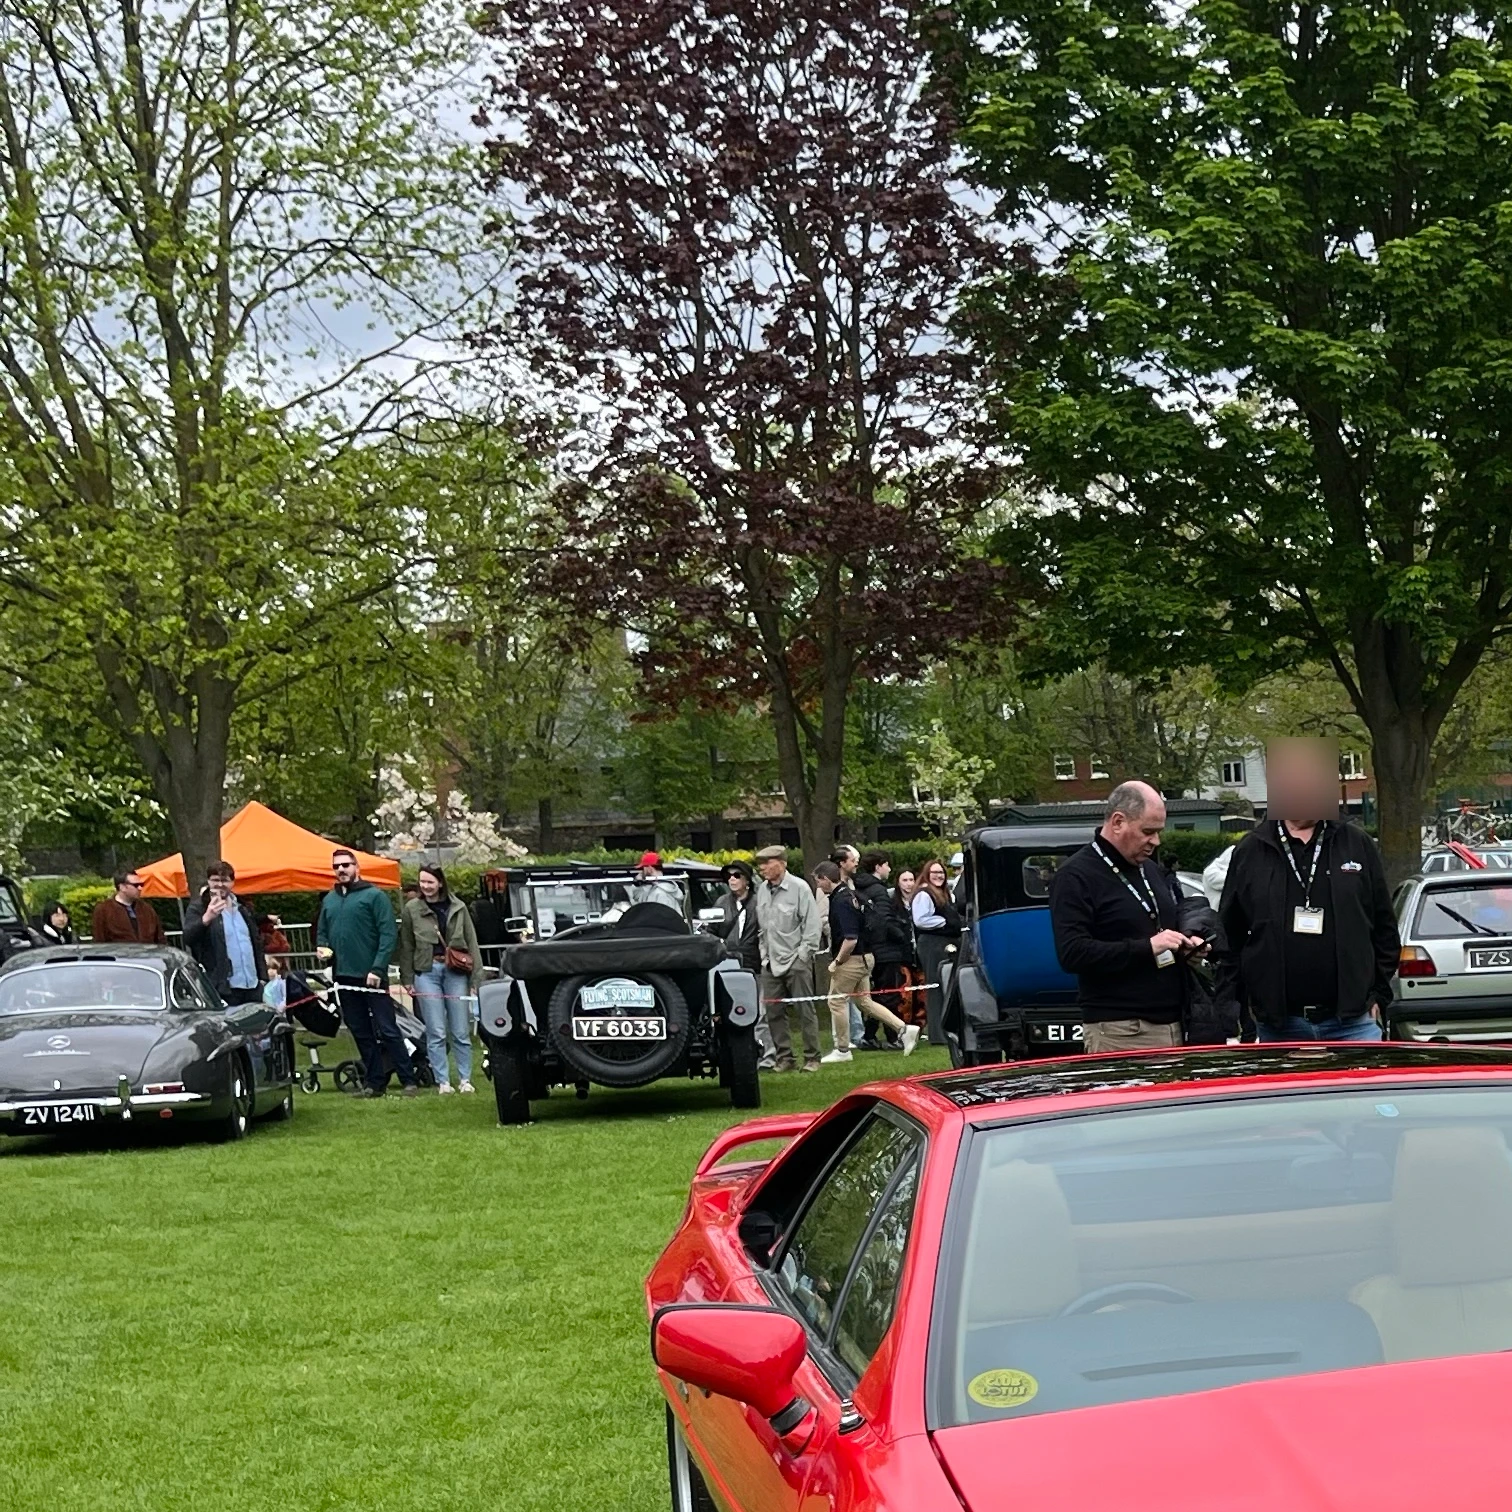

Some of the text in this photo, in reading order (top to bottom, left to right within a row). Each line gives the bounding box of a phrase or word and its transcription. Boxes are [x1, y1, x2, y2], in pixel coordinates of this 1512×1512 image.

[1475, 950, 1511, 966] FZS
[583, 986, 652, 1004] FLYING SCOTSMAN
[579, 1020, 661, 1037] YF 6035
[1047, 1024, 1065, 1041] EI
[23, 1104, 95, 1125] ZV 12411
[985, 1375, 1023, 1387] CLUB
[981, 1387, 1027, 1397] LOTUS
